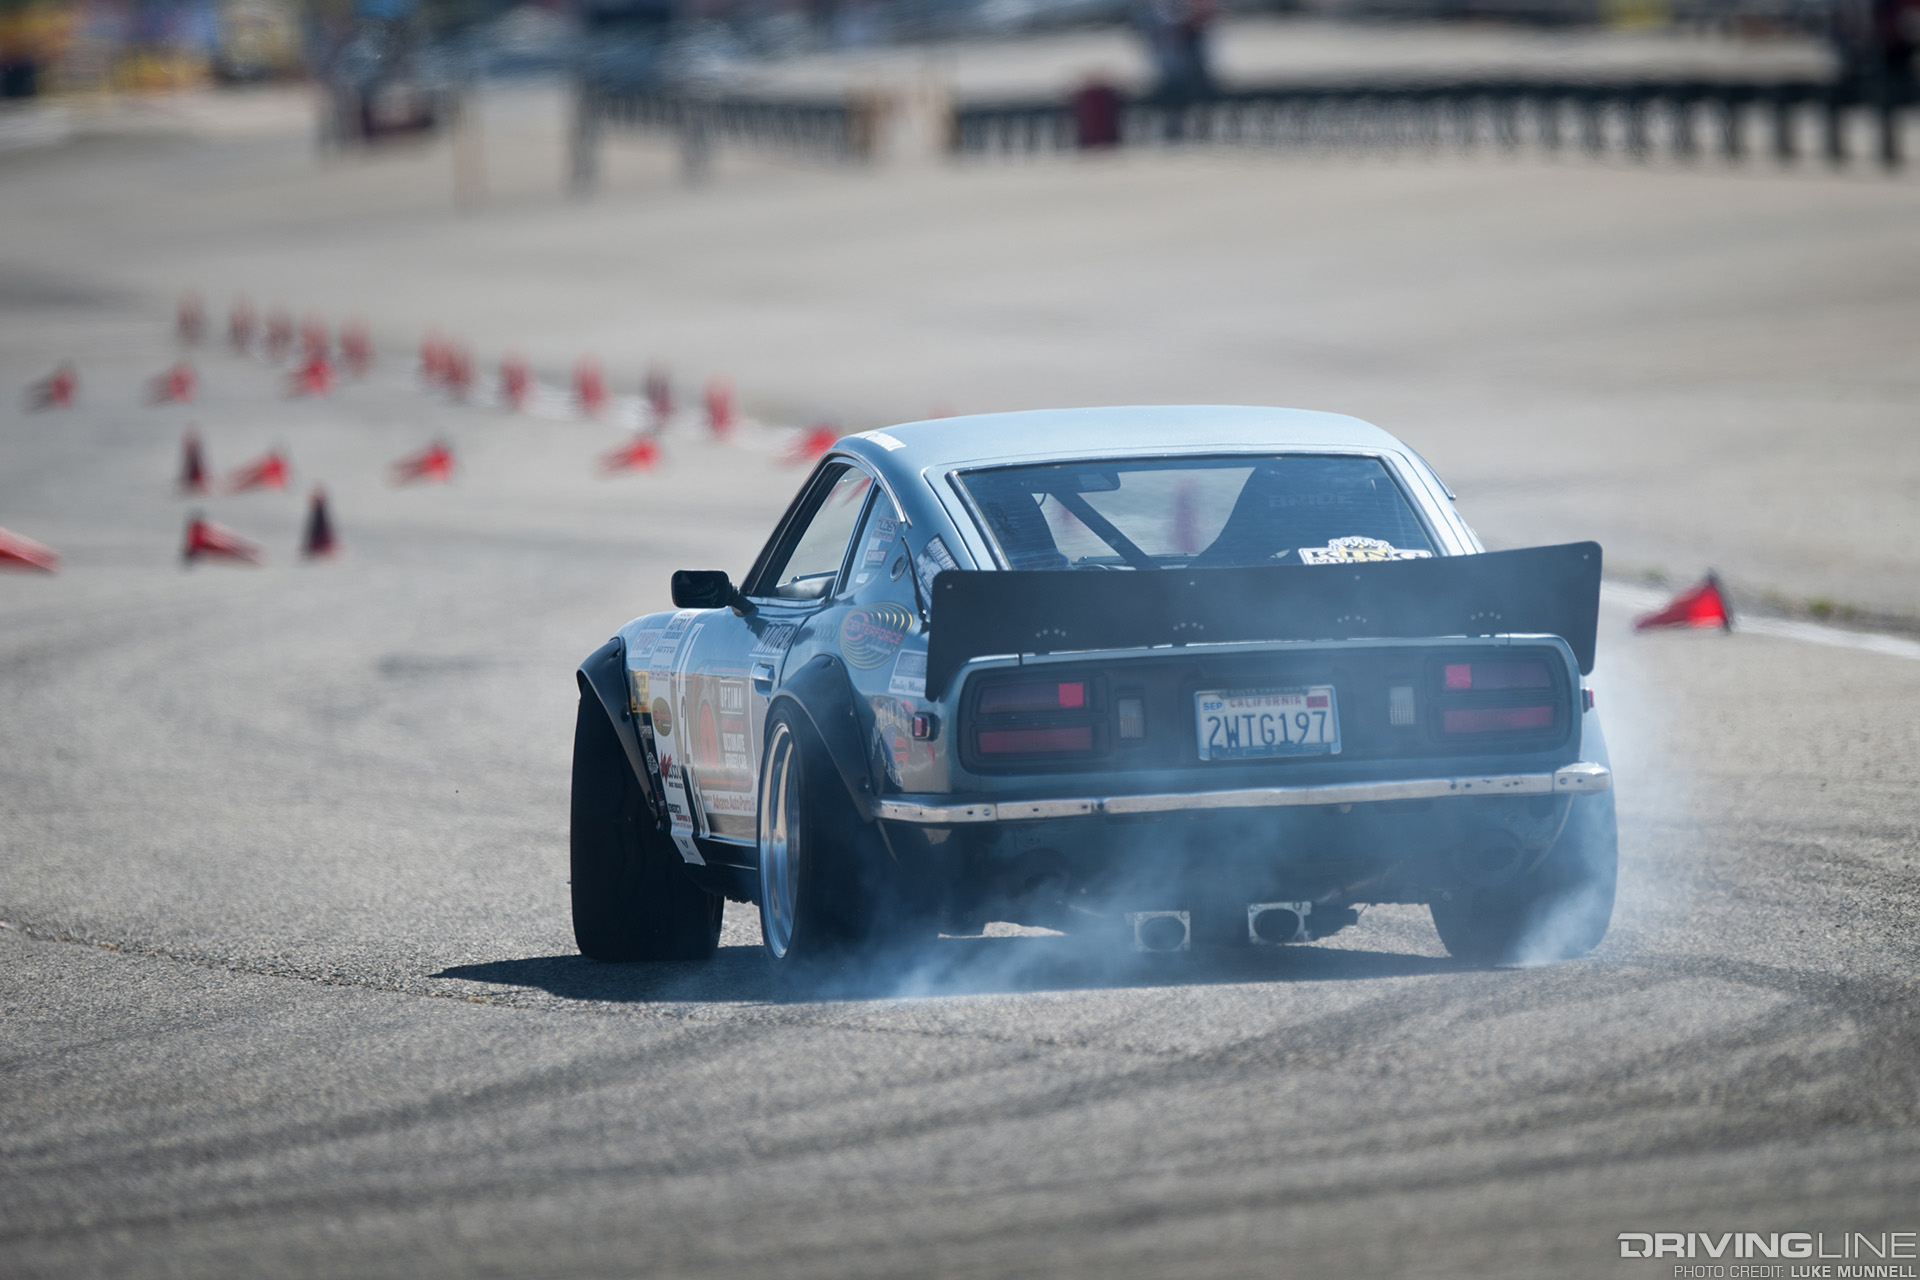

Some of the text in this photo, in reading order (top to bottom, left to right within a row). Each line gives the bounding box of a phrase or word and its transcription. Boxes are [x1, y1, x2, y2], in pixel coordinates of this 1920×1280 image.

[845, 613, 903, 645] CENTERFORCE
[720, 685, 743, 710] OPTIMA
[1203, 701, 1222, 710] SEP
[1229, 696, 1302, 708] CALIFORNIA
[1207, 711, 1327, 748] 2WTG197
